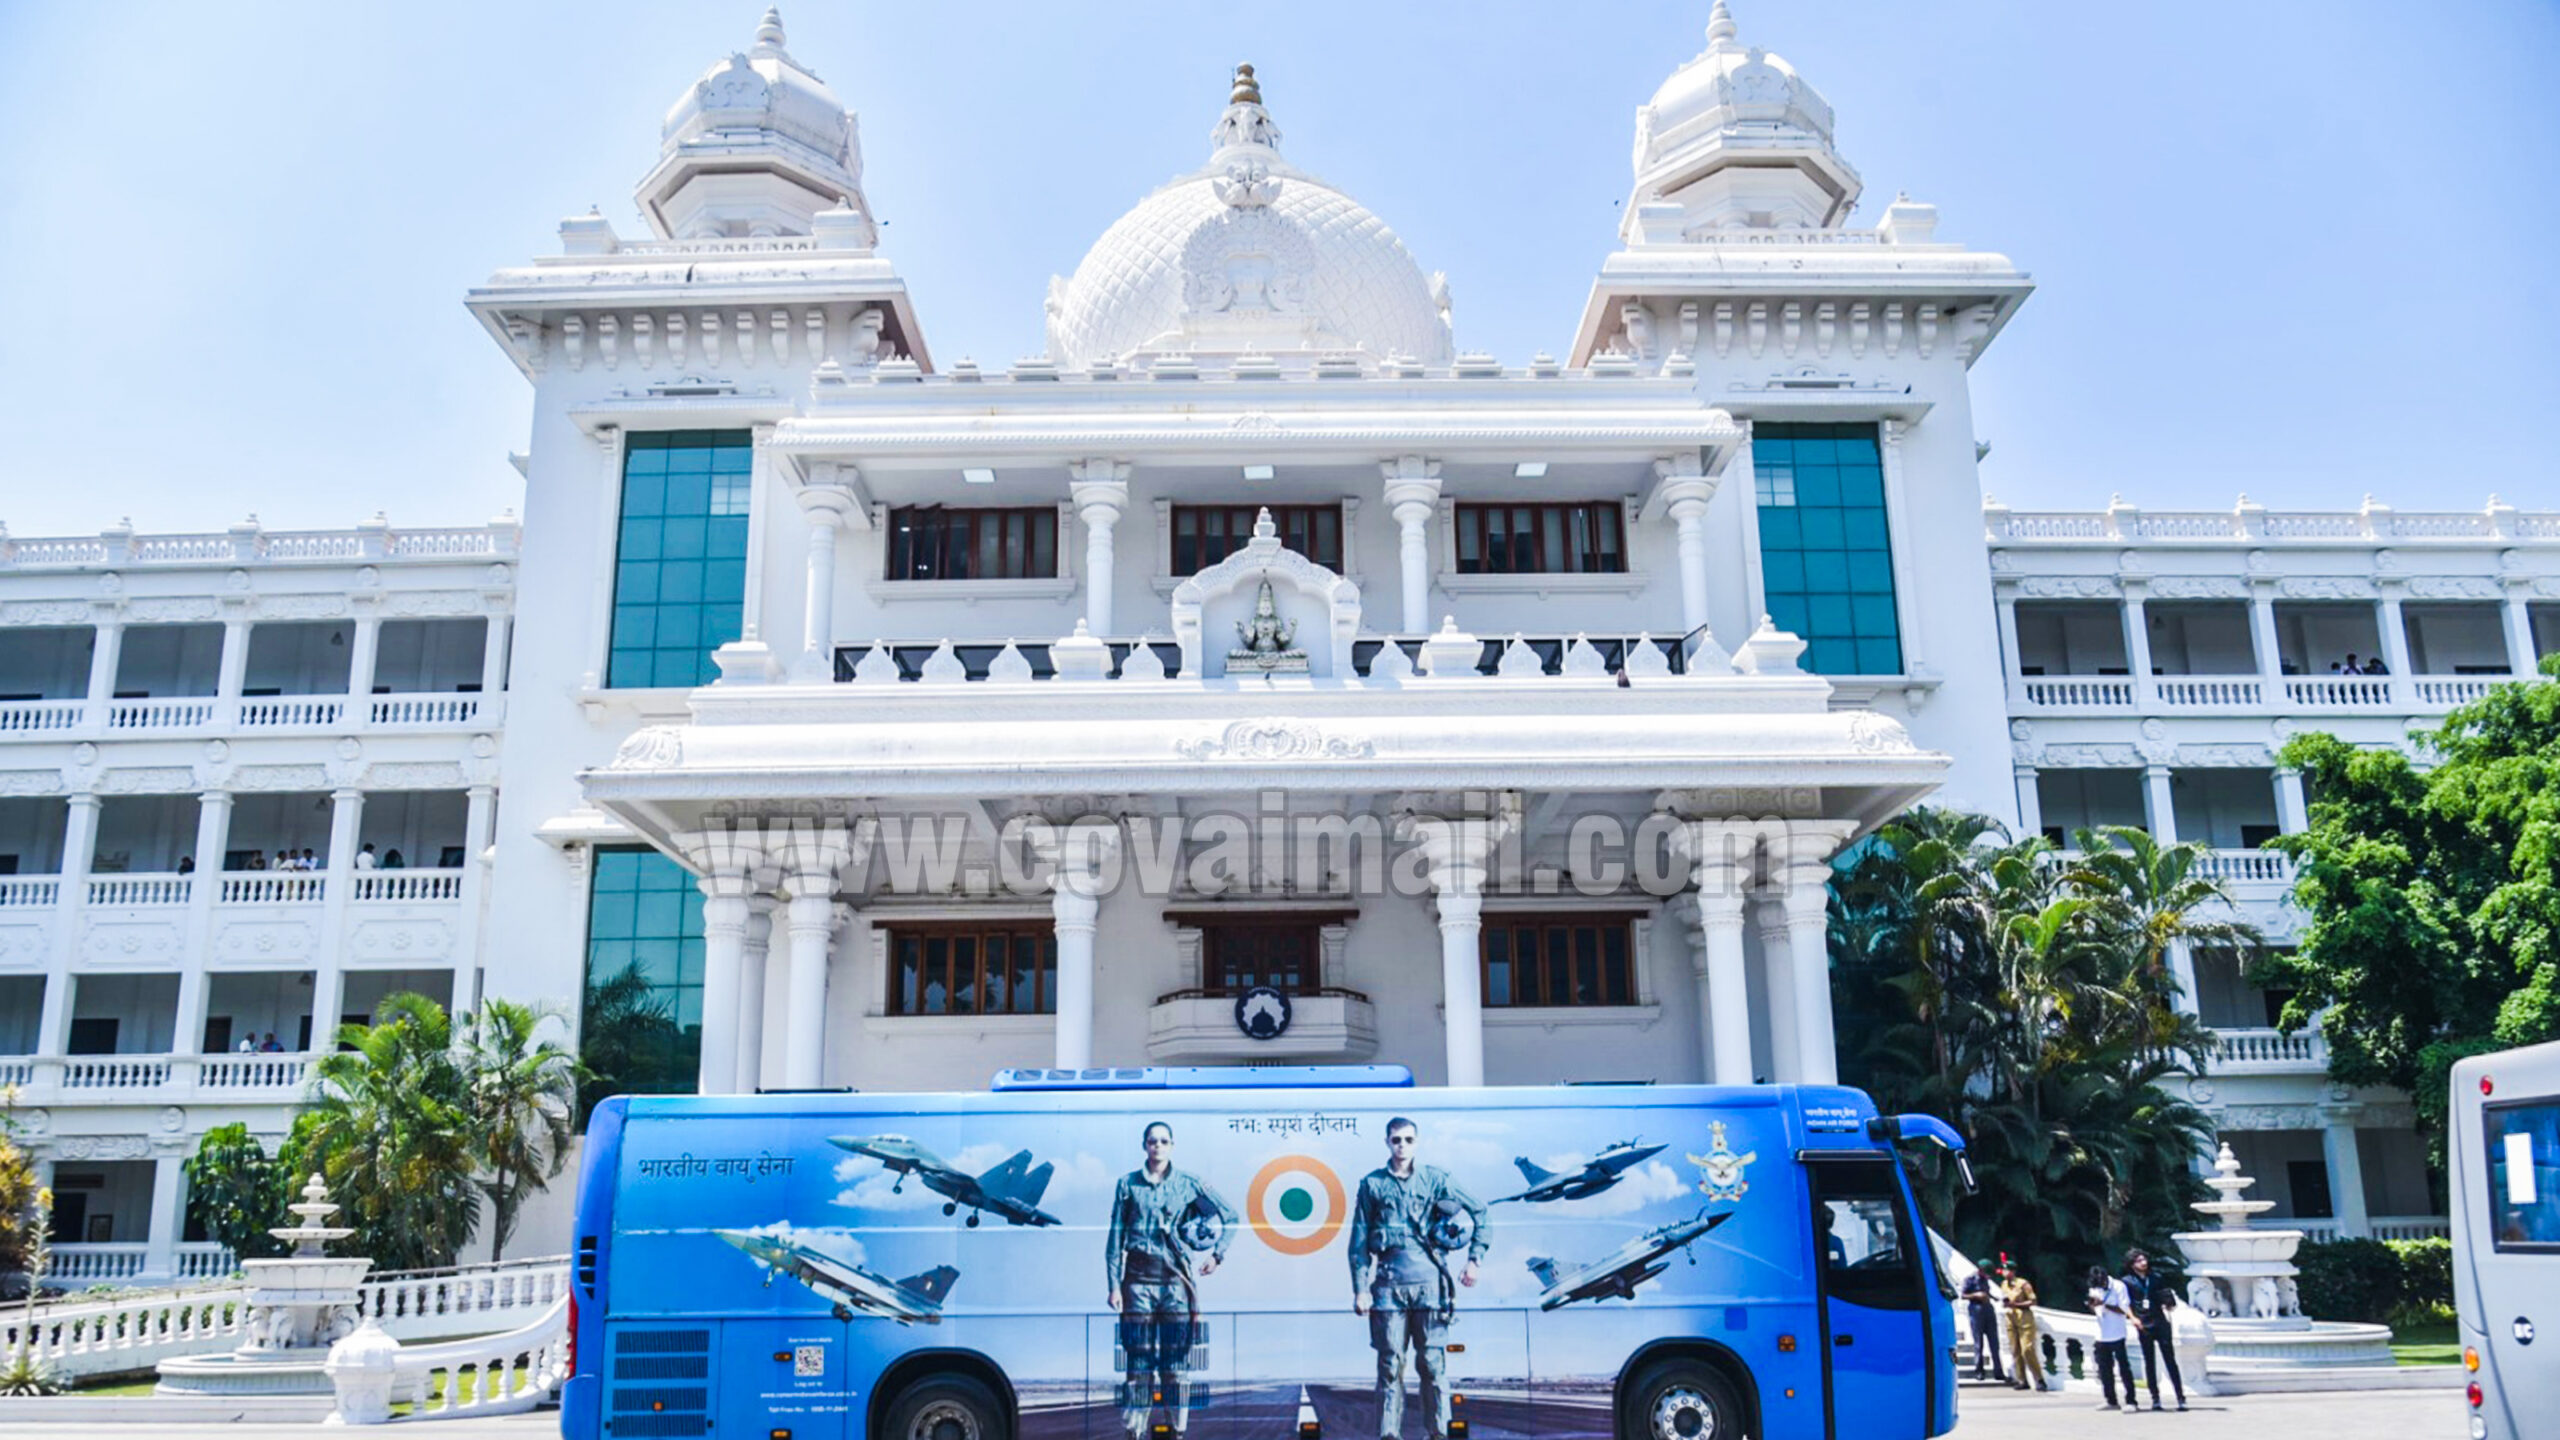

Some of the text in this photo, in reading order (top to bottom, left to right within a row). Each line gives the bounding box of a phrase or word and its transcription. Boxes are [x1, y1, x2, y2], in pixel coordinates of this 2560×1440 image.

[638, 1150, 795, 1184] भारतीय वायु सेना
